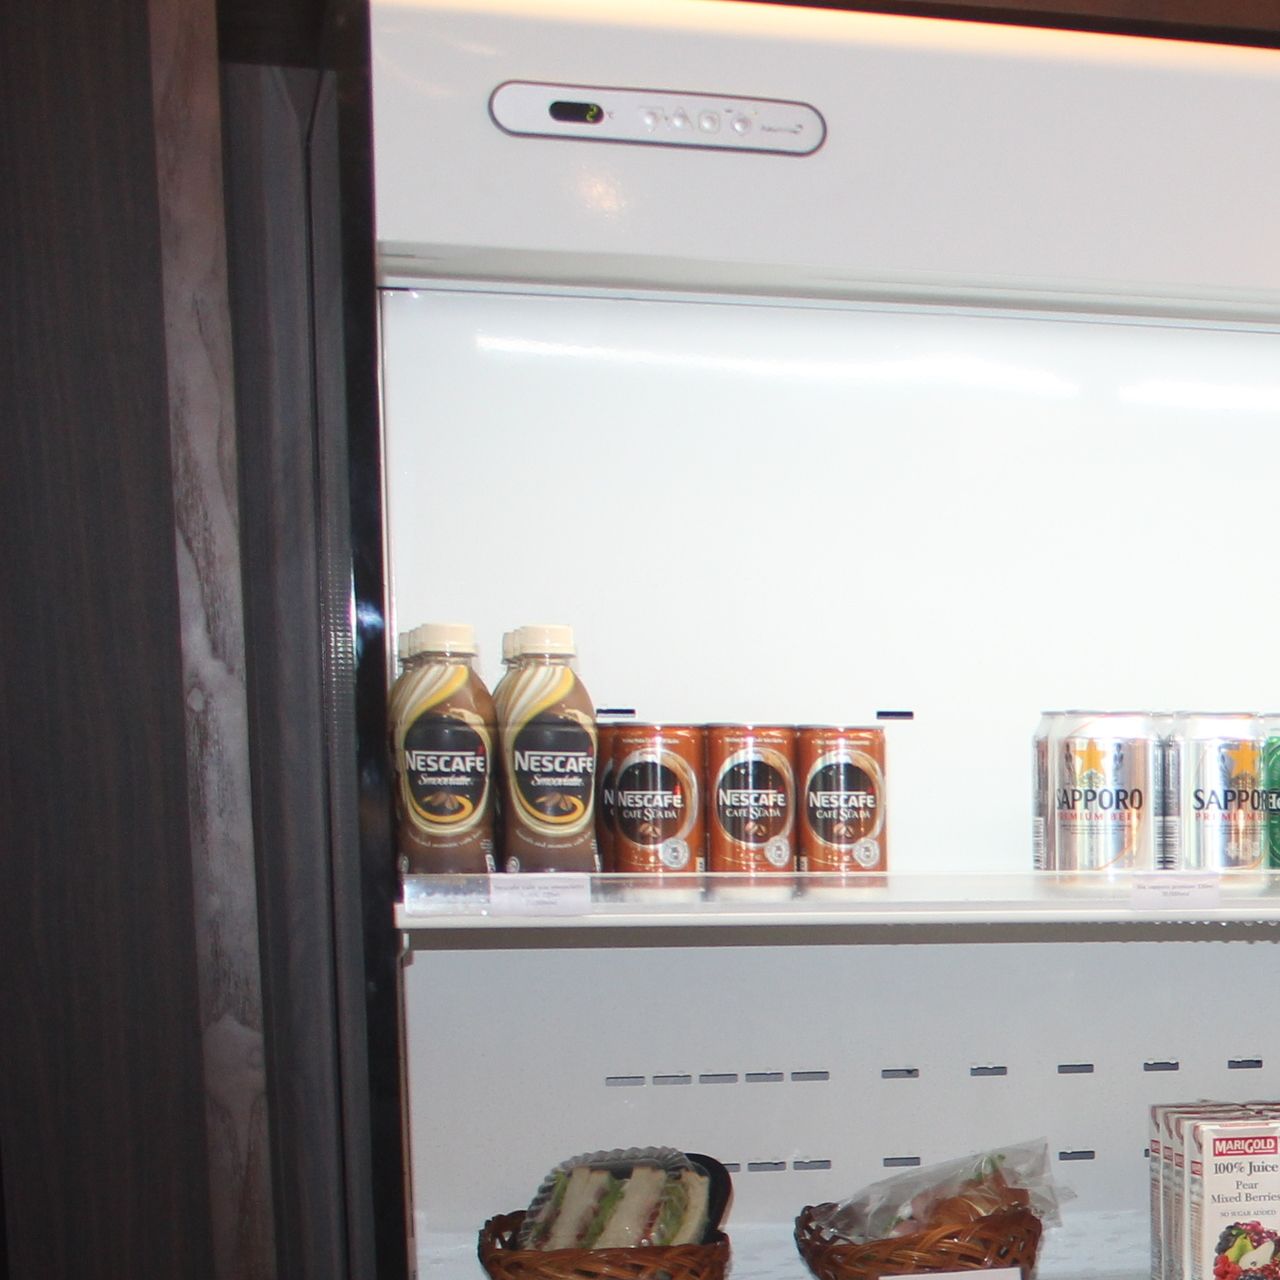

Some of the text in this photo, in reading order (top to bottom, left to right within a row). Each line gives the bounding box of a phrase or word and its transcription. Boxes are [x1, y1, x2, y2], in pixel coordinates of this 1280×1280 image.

[1193, 788, 1266, 811] SAPPO
[1215, 1138, 1276, 1155] MARIGOLD
[1214, 1160, 1278, 1175] 100% Juice
[1235, 1180, 1259, 1190] Pear
[1211, 1193, 1242, 1203] Mixed
